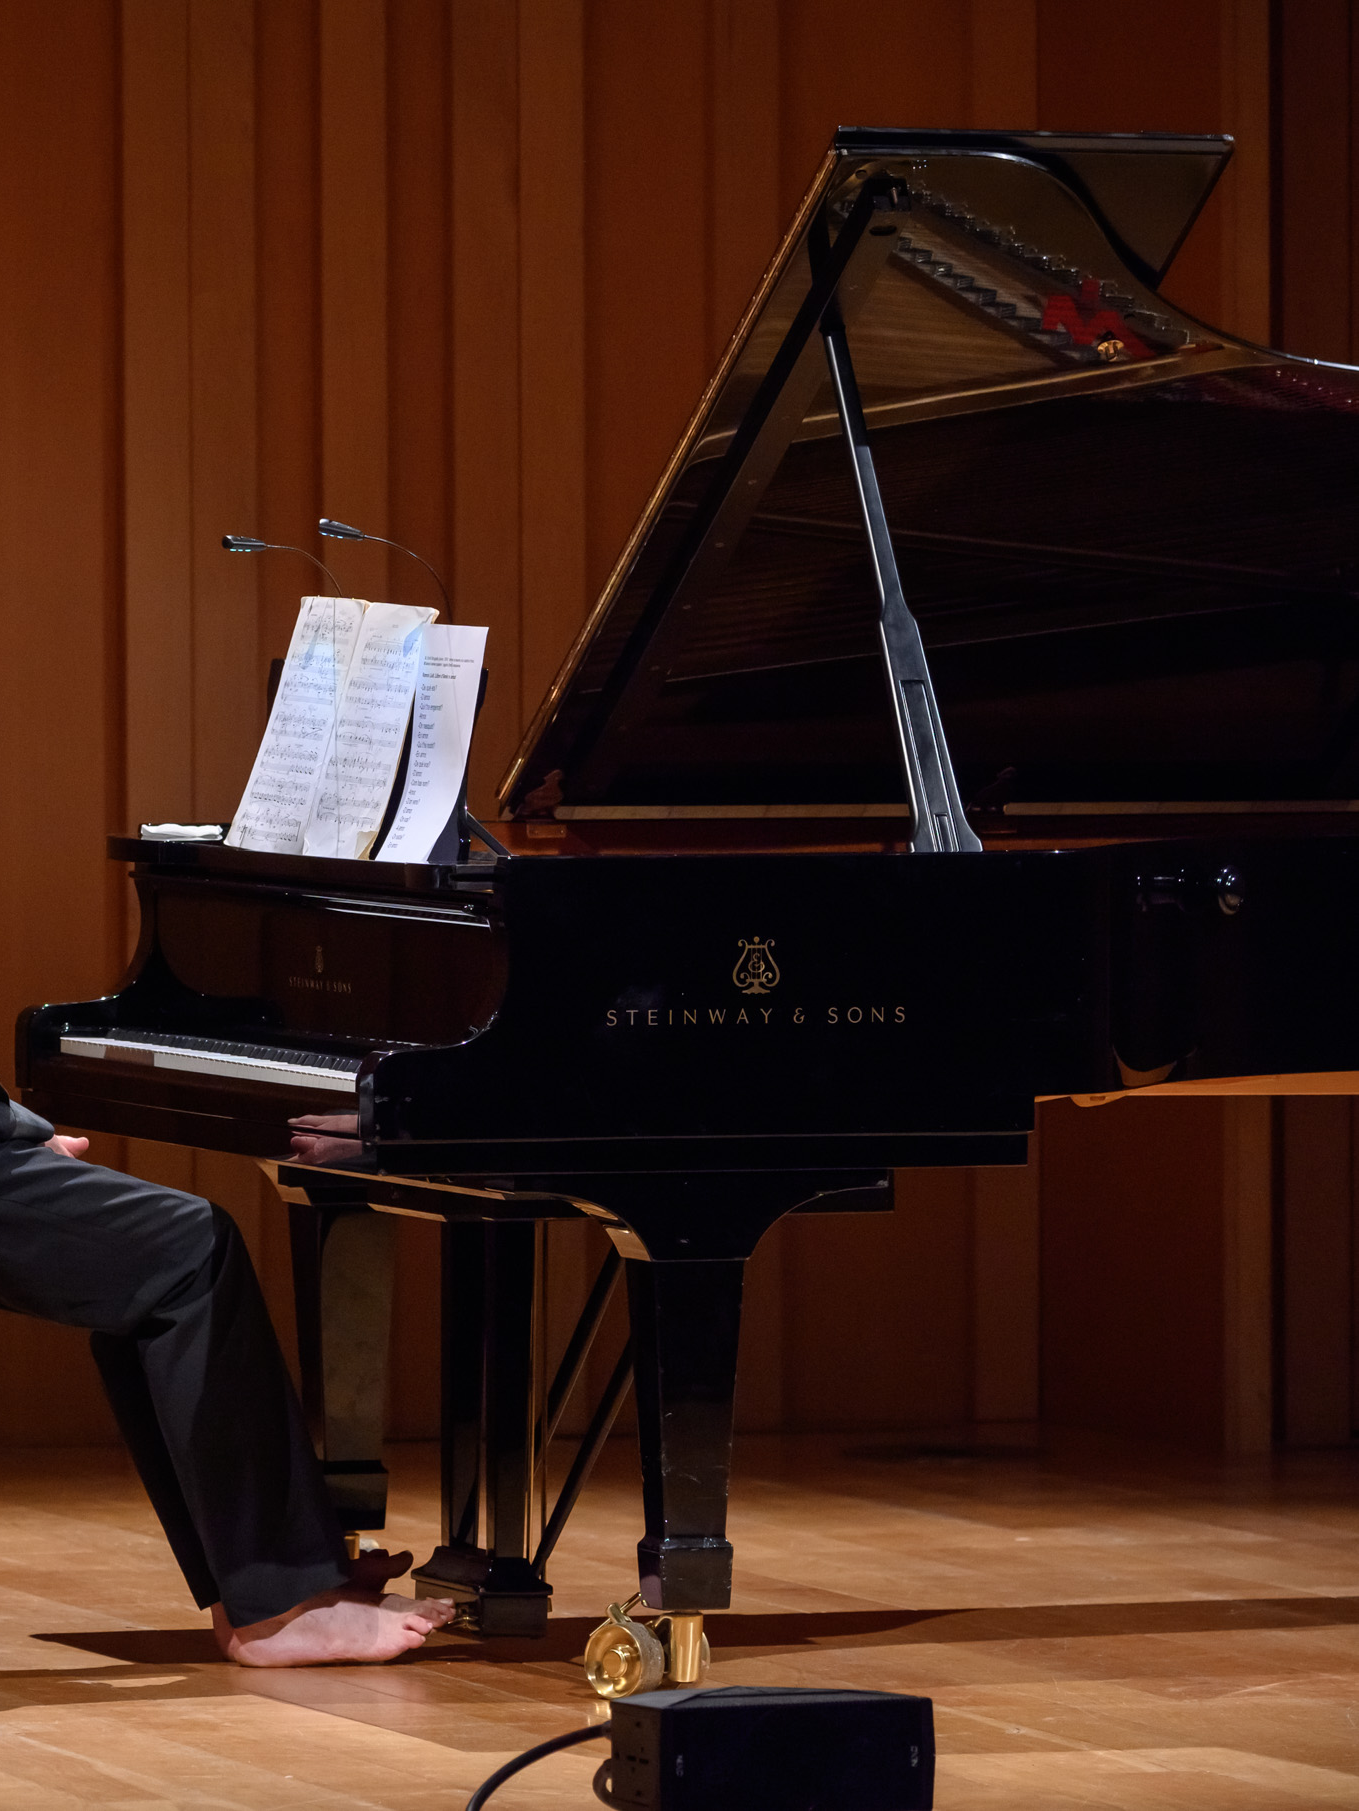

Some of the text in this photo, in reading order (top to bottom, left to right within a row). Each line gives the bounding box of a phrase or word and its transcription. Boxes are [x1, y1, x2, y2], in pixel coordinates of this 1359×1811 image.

[289, 976, 323, 990] STEINWAY
[333, 981, 351, 994] SONS
[606, 1006, 906, 1027] STEINWAY & SONS
